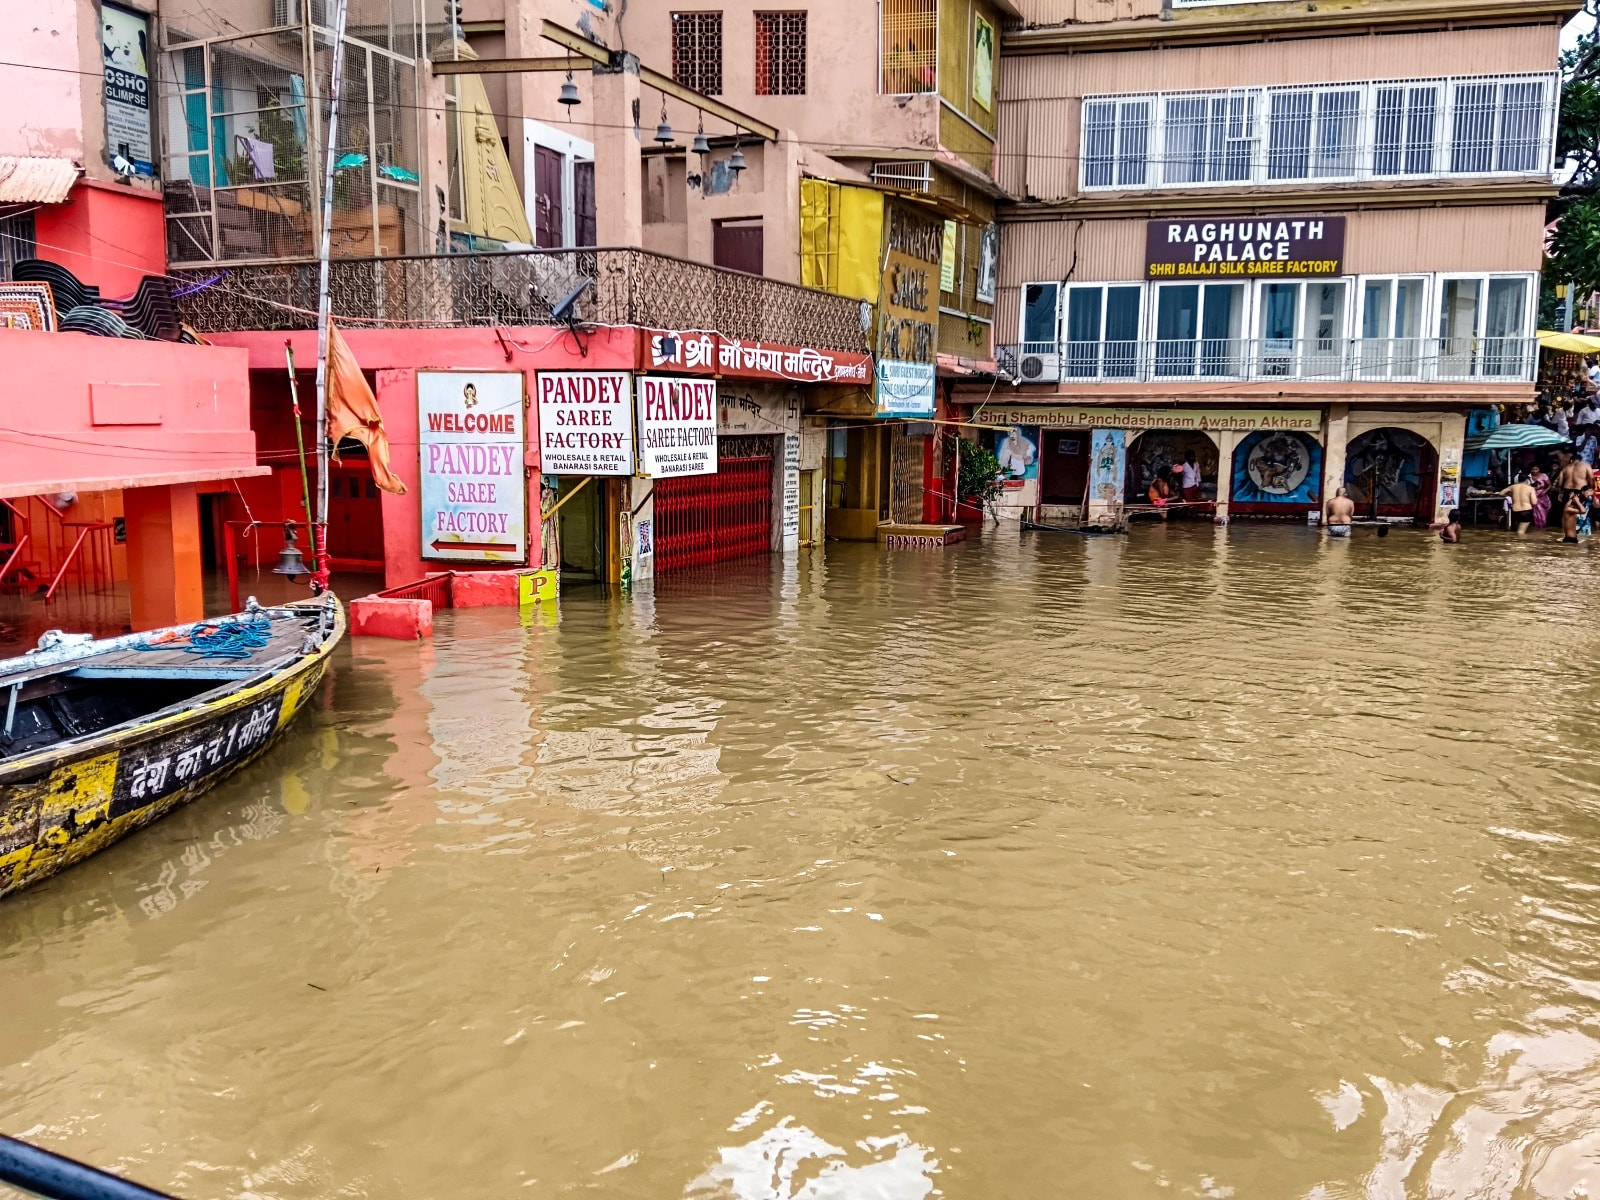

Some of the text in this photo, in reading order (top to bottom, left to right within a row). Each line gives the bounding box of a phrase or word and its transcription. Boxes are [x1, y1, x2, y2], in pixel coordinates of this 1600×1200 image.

[105, 69, 147, 93] OSHO
[105, 86, 147, 106] GLIMPSE
[1167, 221, 1324, 243] RAGHUNATH
[1194, 242, 1290, 262] PALACE
[1149, 260, 1338, 275] SHRI BALAJI SILK SAREE FACTORY
[685, 334, 714, 368] श्री
[719, 339, 743, 370] माँ
[744, 342, 784, 373] गंगा
[900, 366, 914, 379] GUEST
[542, 376, 624, 404] PANDEY
[644, 381, 714, 421] PANDEY
[428, 413, 516, 434] WELCOME
[556, 409, 612, 426] SAREE
[979, 410, 1312, 428] Shri Shambhu Panchdashnaam Awahan Akhara
[545, 432, 624, 449] FACTORY
[646, 427, 715, 449] SAREE FACTORY
[428, 444, 516, 476] PANDEY
[545, 453, 627, 462] WHOLESALE & RETAIL
[553, 462, 619, 471] BANARASI SAREE
[655, 453, 687, 463] WHOLESALE
[693, 452, 709, 460] RETAIL
[661, 462, 704, 474] BANARASI SAREE
[448, 482, 497, 503] SAREE
[437, 511, 508, 533] FACTORY
[130, 754, 171, 799] देश
[175, 745, 204, 780] का
[238, 703, 277, 750] सीमेंट
